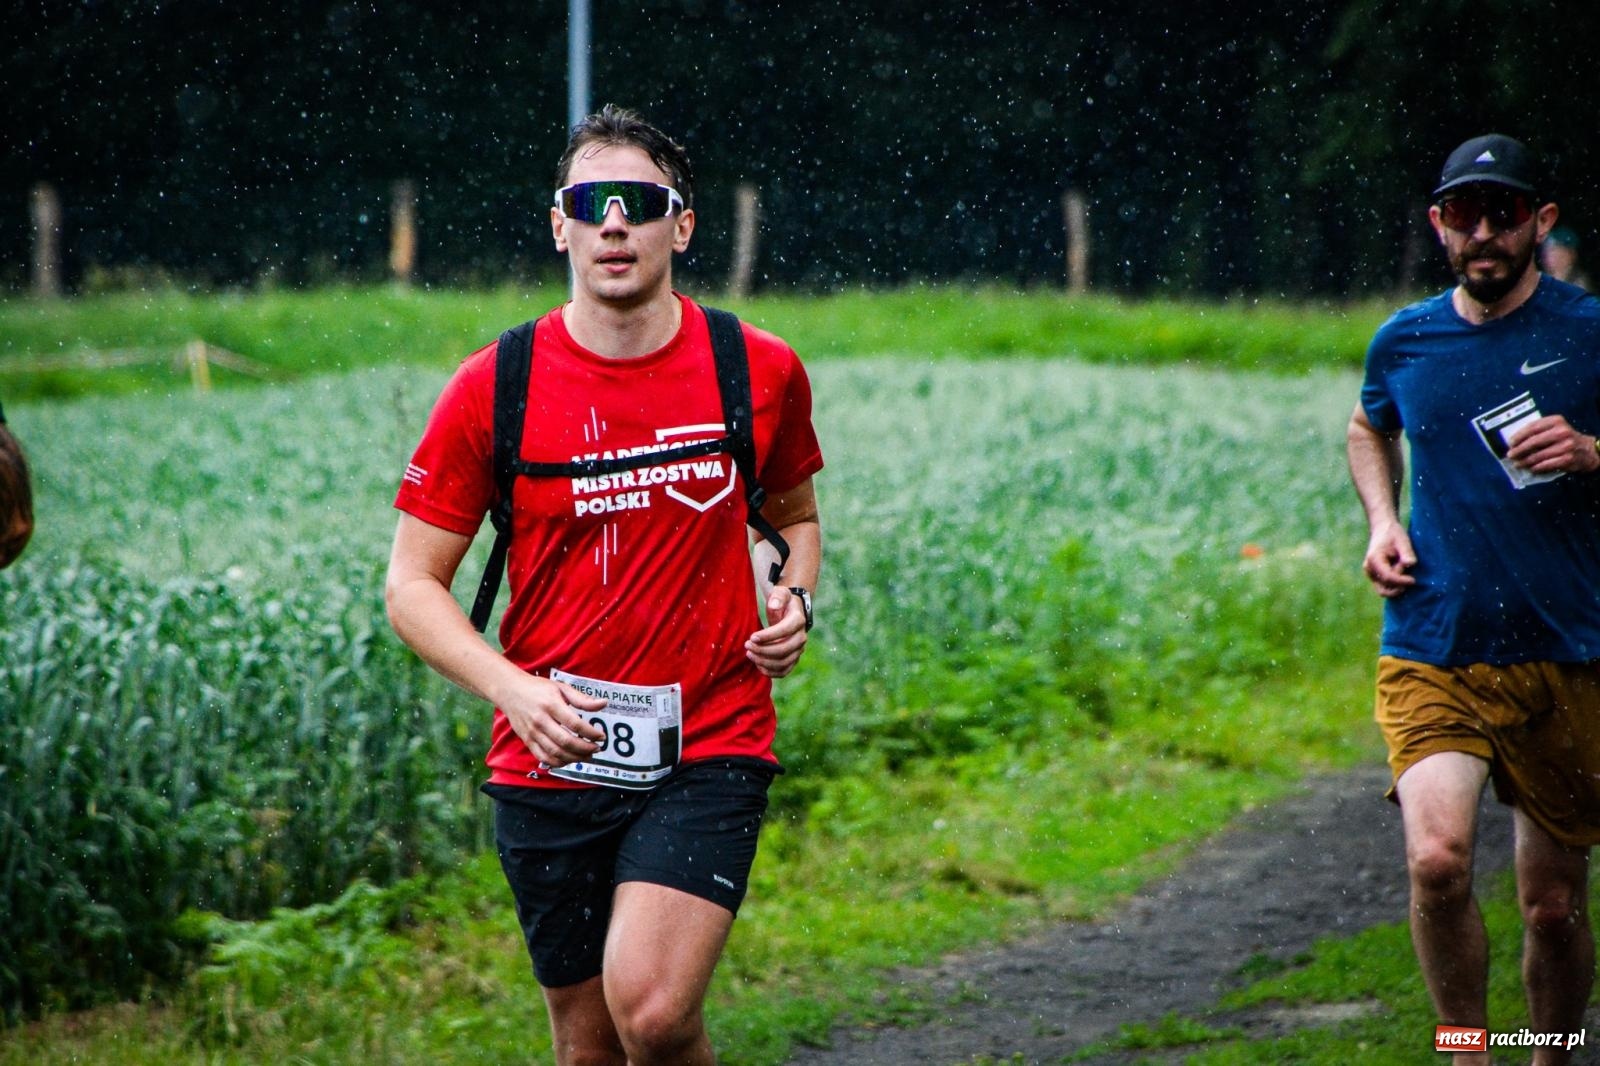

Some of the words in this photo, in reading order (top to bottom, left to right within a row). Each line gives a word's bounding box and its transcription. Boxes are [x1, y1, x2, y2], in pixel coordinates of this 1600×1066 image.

[571, 460, 724, 495] MISTRZOSTWA
[574, 490, 651, 517] POLSKI
[594, 688, 610, 700] NA
[612, 691, 652, 707] PIĄTKĘ
